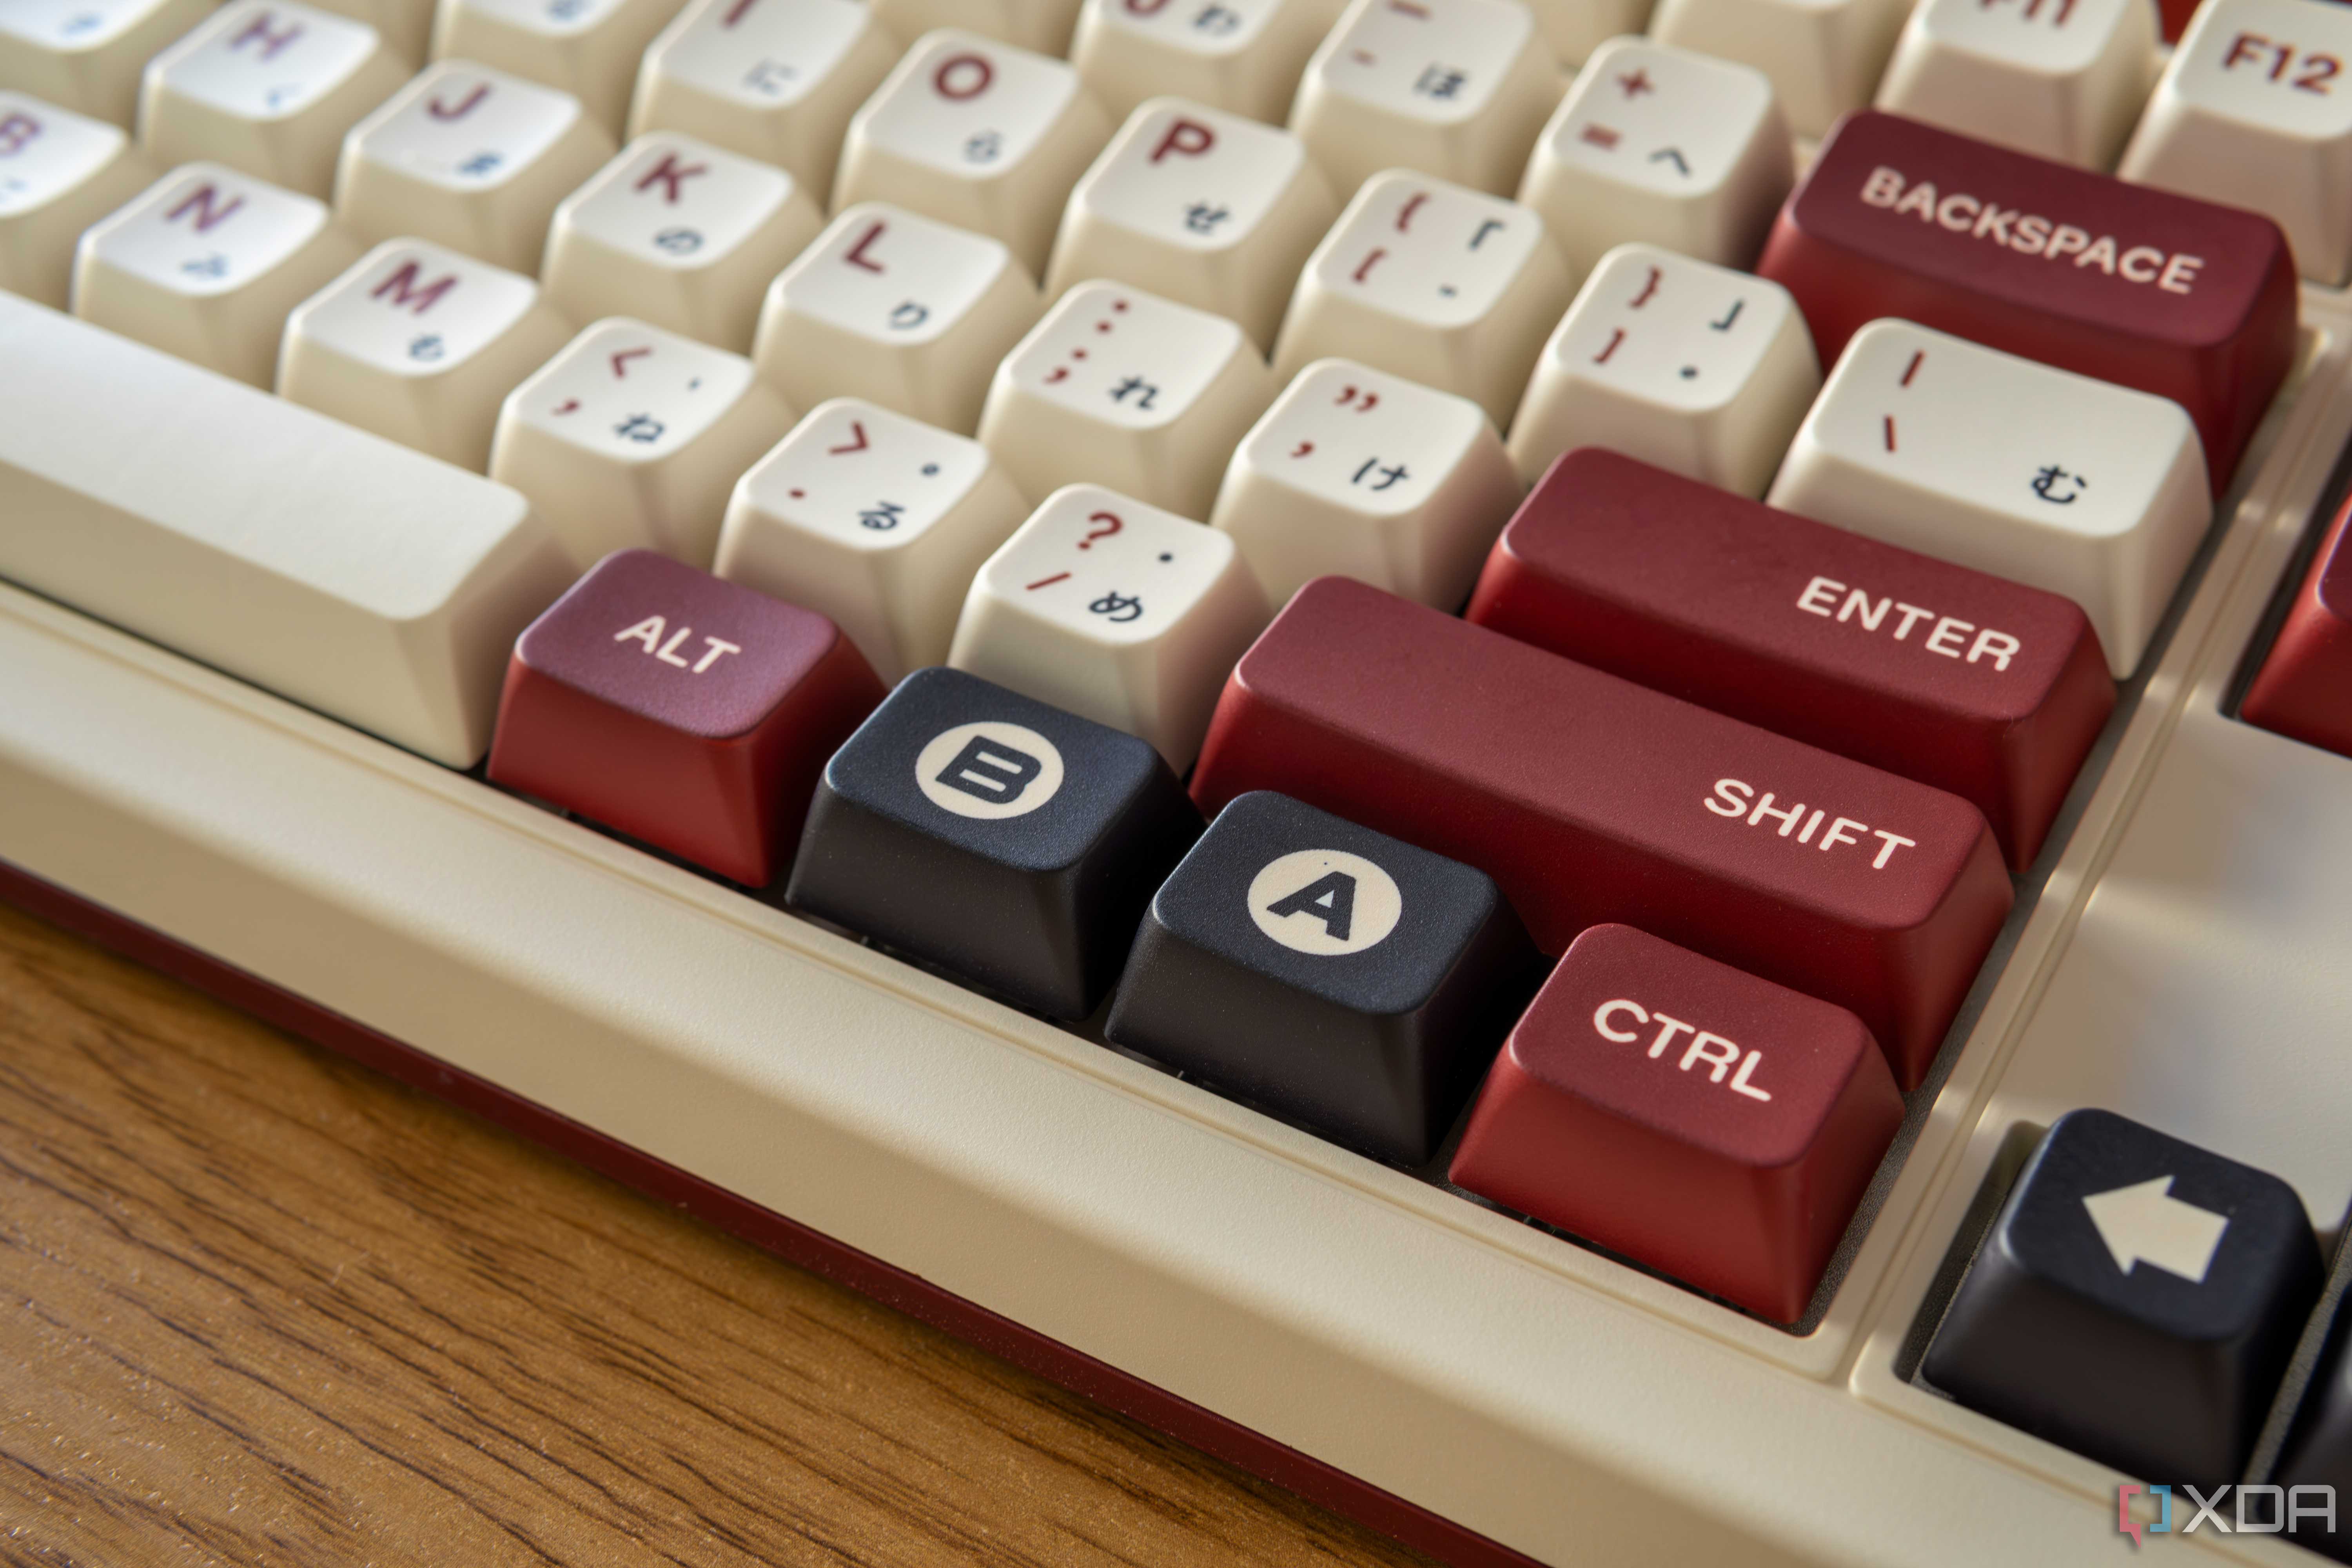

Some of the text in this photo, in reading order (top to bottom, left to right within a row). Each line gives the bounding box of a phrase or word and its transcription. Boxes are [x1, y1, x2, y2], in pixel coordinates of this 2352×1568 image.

[230, 13, 302, 60] H
[933, 54, 995, 102] O
[1416, 68, 1465, 99] は
[2223, 34, 2342, 94] F12
[426, 85, 490, 122] J
[1151, 119, 1216, 163] P
[636, 154, 704, 204] K
[166, 183, 243, 232] N
[1186, 204, 1229, 233] せ
[1860, 165, 2204, 294] BACKSPACE
[654, 229, 703, 253] の
[845, 223, 885, 273] L
[372, 261, 457, 314] M
[1111, 378, 1157, 409] れ
[616, 415, 664, 443] ね
[1352, 459, 1408, 490] け
[2031, 466, 2086, 504] む
[860, 503, 904, 530] る
[1078, 512, 1123, 550] ?
[1089, 592, 1143, 622] め
[1797, 577, 2020, 671] ENTER
[615, 616, 740, 673] ALT
[935, 735, 1042, 804] B
[1704, 779, 1916, 869] SHIFT
[1267, 871, 1357, 941] A
[1594, 999, 1771, 1101] CTRL
